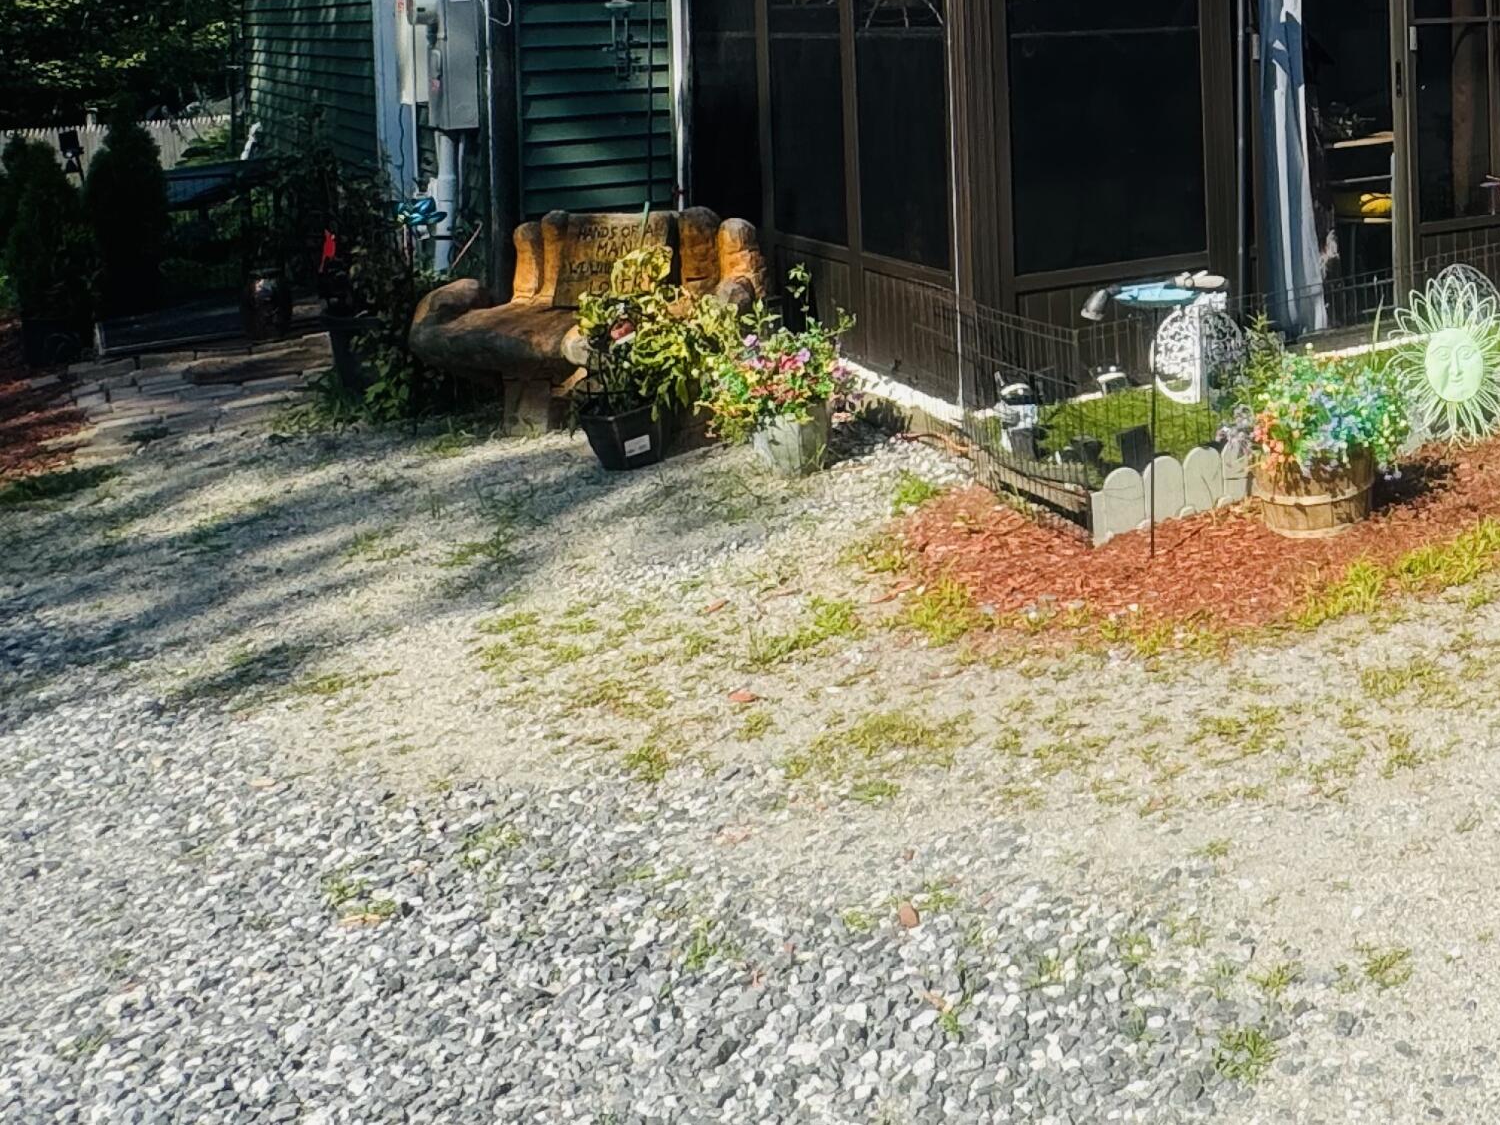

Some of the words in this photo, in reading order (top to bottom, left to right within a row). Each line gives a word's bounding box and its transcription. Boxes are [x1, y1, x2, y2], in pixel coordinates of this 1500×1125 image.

[578, 225, 618, 241] HANDS
[621, 225, 640, 239] OF
[596, 239, 633, 258] MAN
